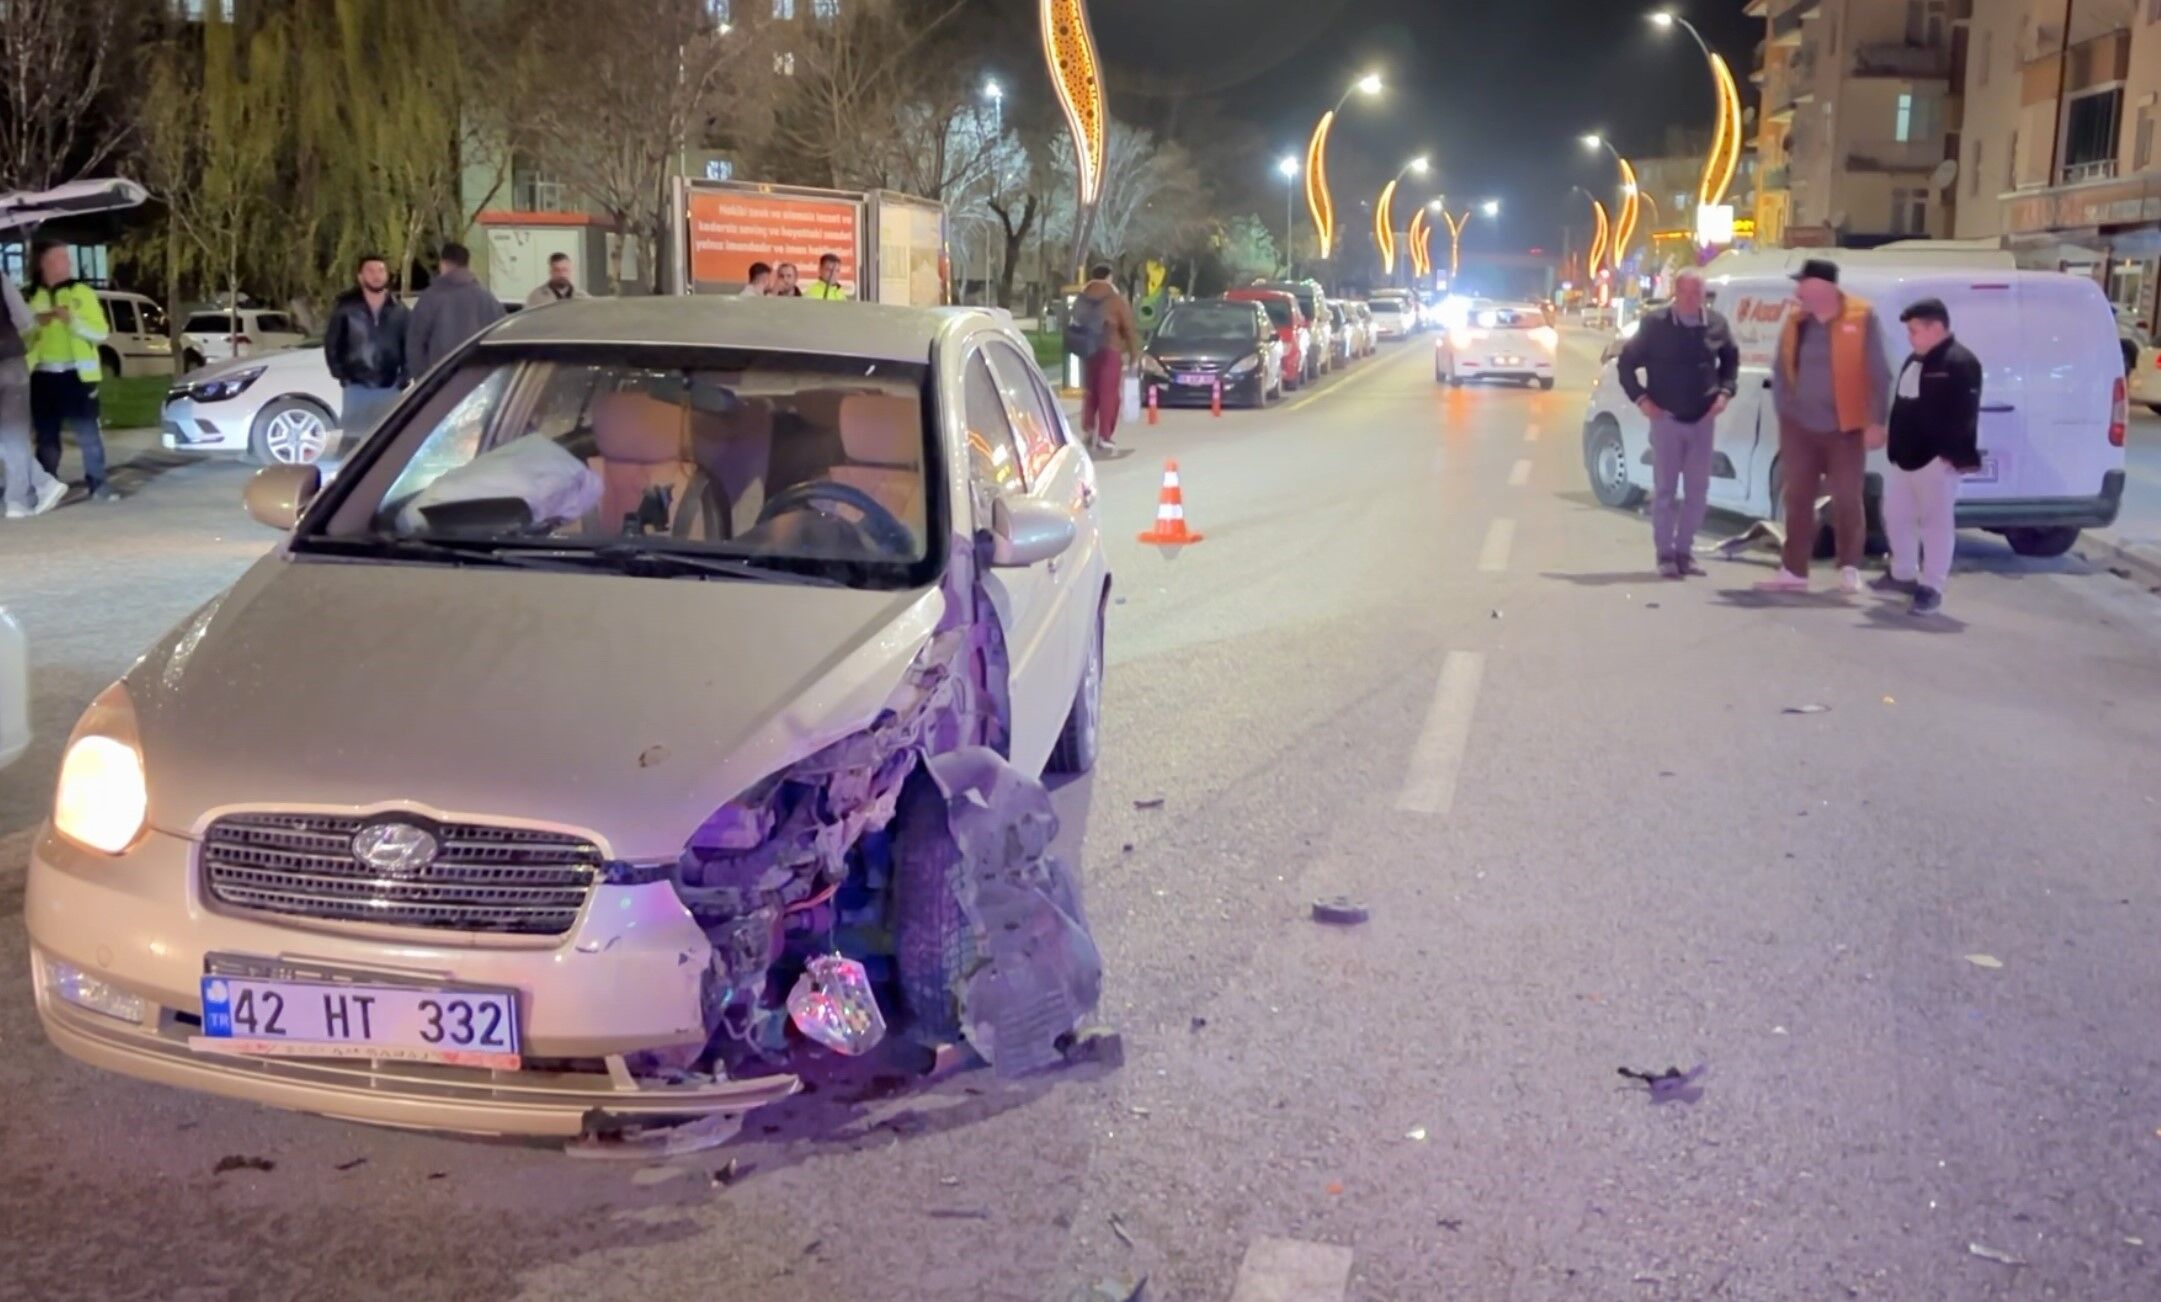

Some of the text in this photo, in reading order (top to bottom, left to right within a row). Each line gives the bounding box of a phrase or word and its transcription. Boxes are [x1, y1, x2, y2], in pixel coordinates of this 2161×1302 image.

[210, 1012, 230, 1028] TR
[234, 988, 504, 1046] 42 HT 332
